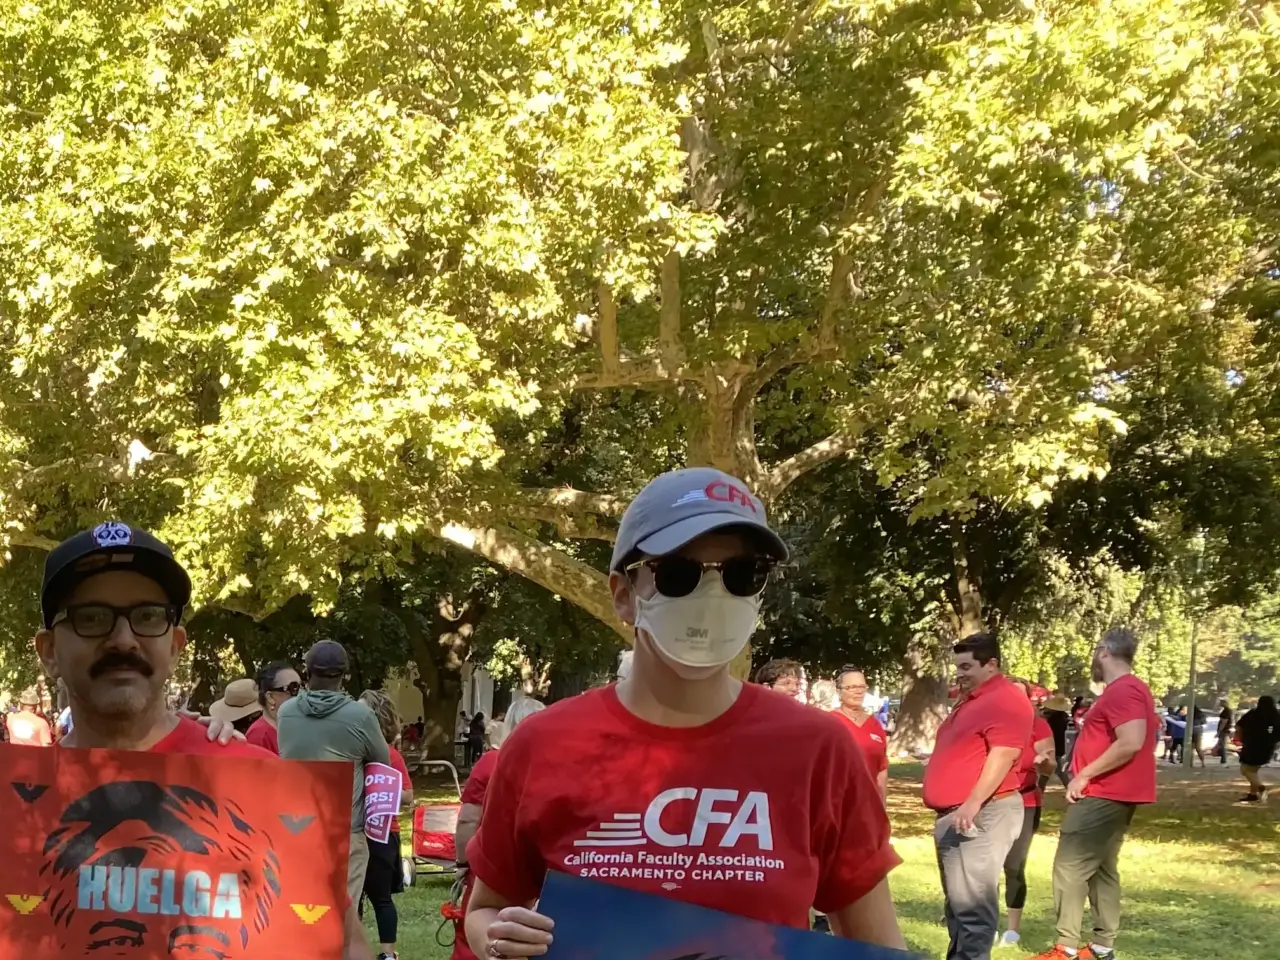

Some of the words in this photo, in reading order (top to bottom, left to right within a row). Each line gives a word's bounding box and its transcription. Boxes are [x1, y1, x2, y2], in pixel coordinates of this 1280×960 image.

[704, 479, 756, 513] CFA
[686, 627, 709, 638] 3M
[643, 787, 773, 850] CFA
[563, 851, 634, 866] California
[637, 851, 694, 868] Faculty
[696, 852, 785, 869] Association
[580, 867, 686, 880] SACRAMENTO
[691, 869, 765, 882] CHAPTER
[77, 864, 242, 919] HUELGA
